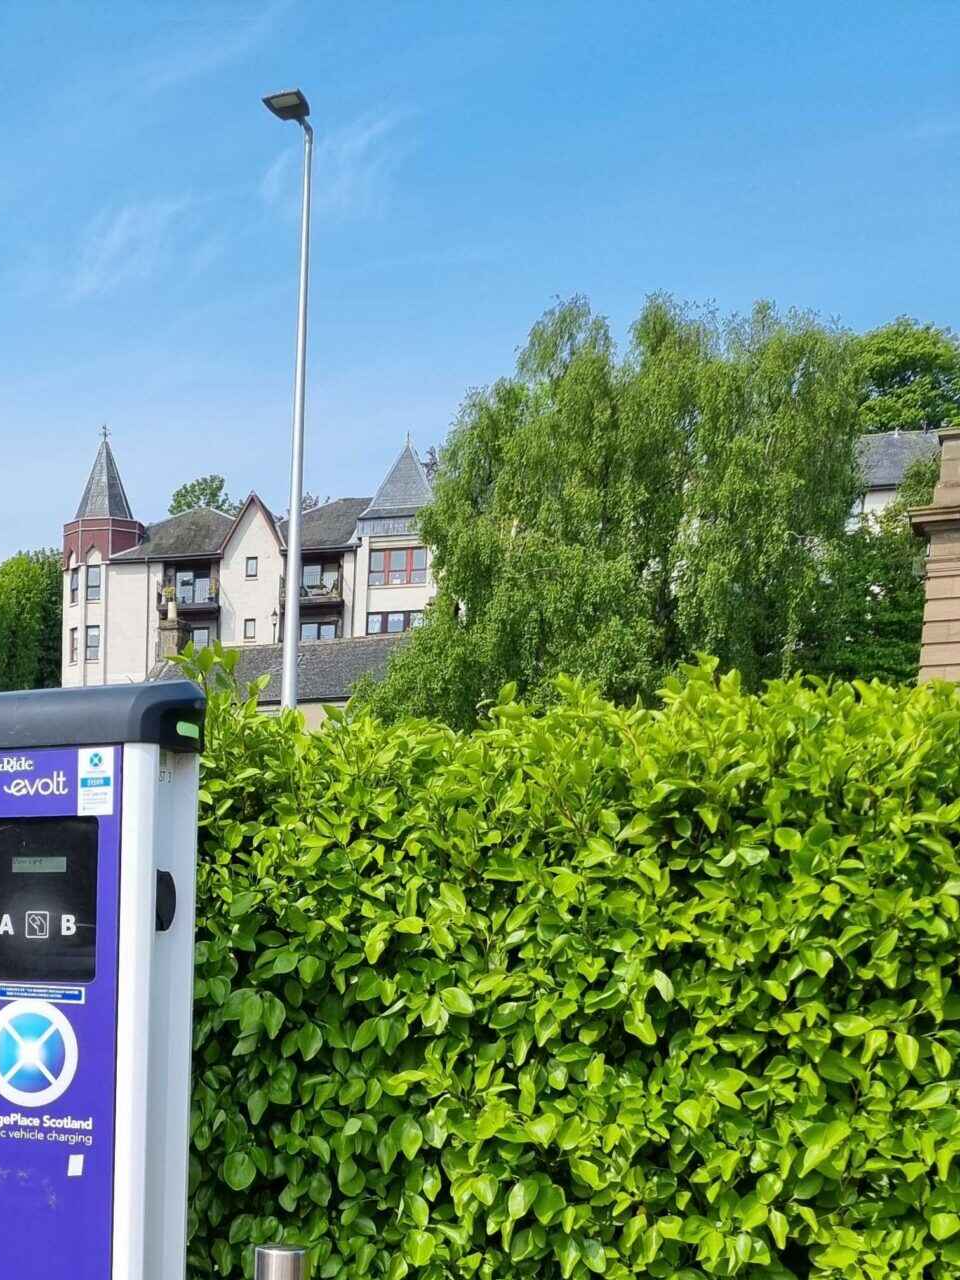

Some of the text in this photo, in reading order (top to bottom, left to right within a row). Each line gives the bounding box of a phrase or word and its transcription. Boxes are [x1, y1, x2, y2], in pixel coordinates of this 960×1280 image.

[3, 770, 68, 796] evolt
[61, 914, 77, 936] B
[42, 1114, 93, 1130] Scotland
[8, 1127, 45, 1140] vehicle
[46, 1130, 93, 1145] charging
